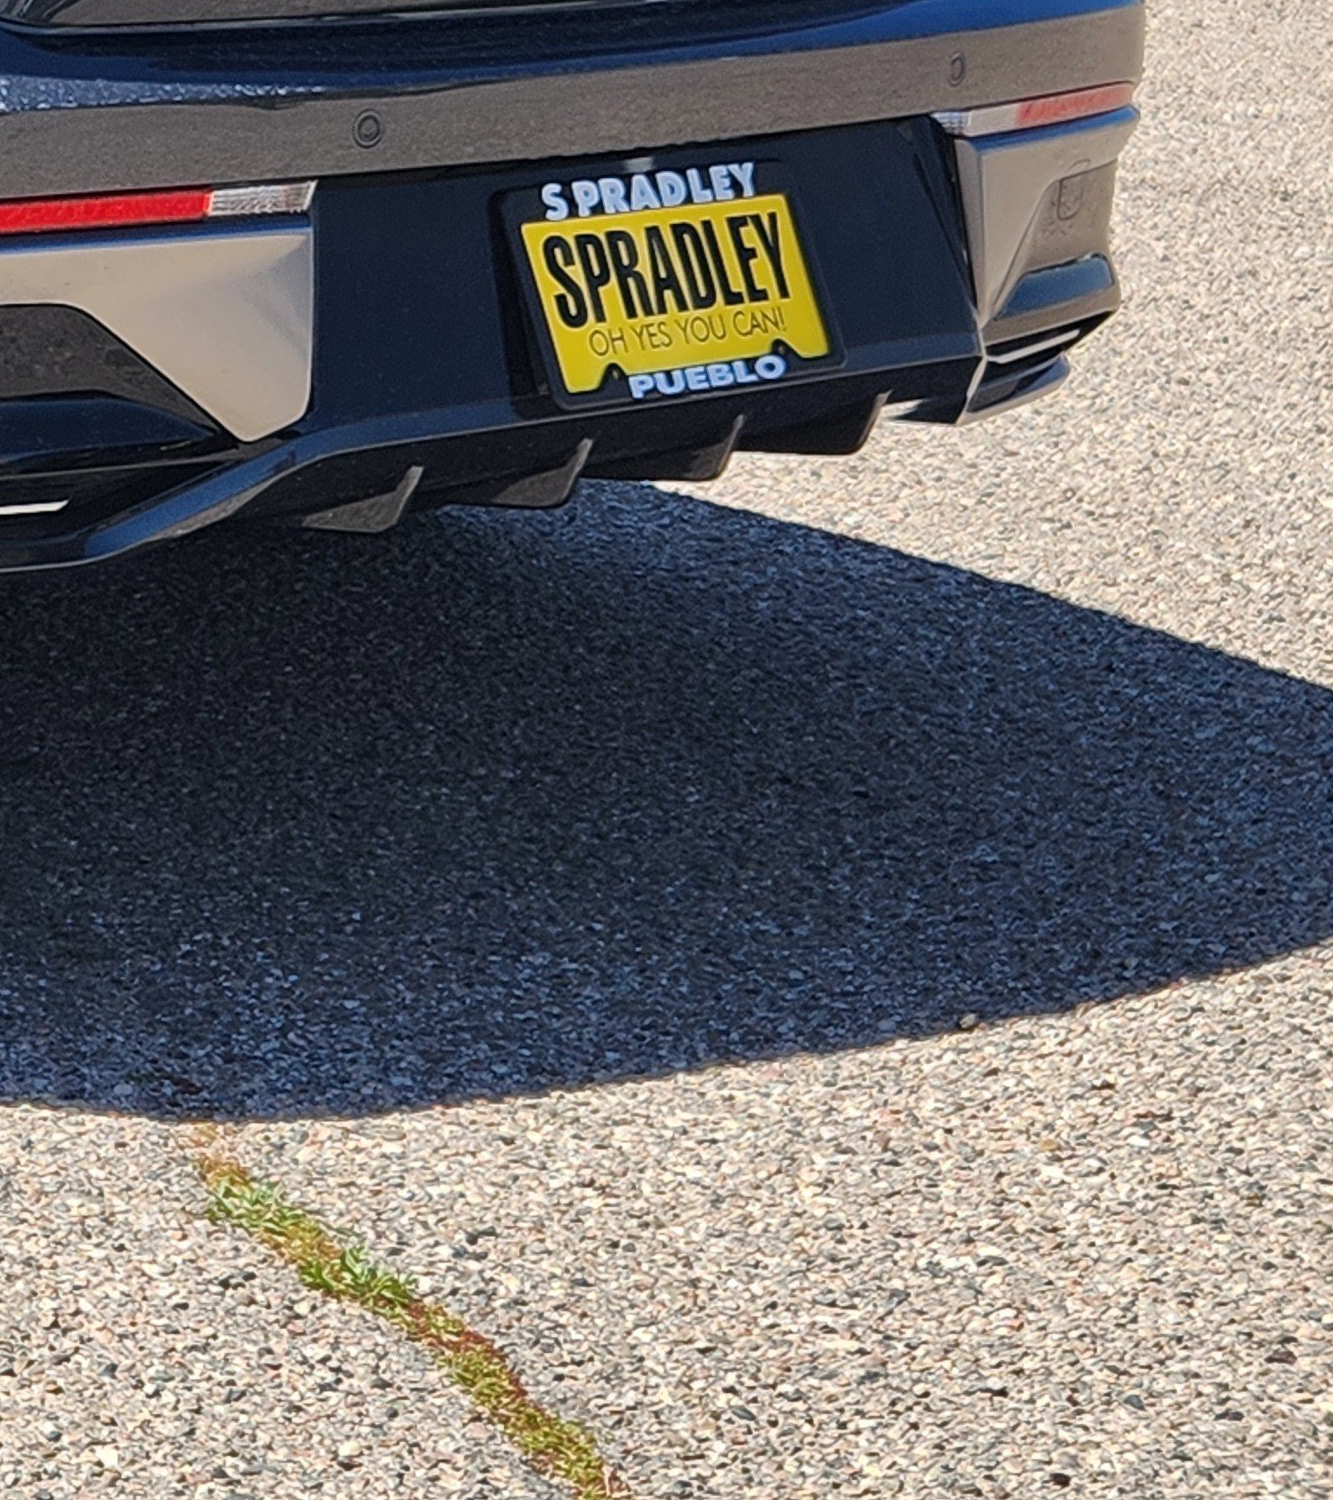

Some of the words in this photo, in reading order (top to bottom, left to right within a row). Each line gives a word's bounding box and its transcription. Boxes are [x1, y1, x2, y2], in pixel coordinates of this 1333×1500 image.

[541, 162, 756, 221] SPRADLEY
[541, 211, 791, 329] SPRADLEY
[588, 328, 629, 356] OH
[630, 321, 673, 350] YES
[675, 315, 727, 343] YOU
[733, 306, 786, 337] CAN!
[627, 354, 787, 399] PUEBLO
